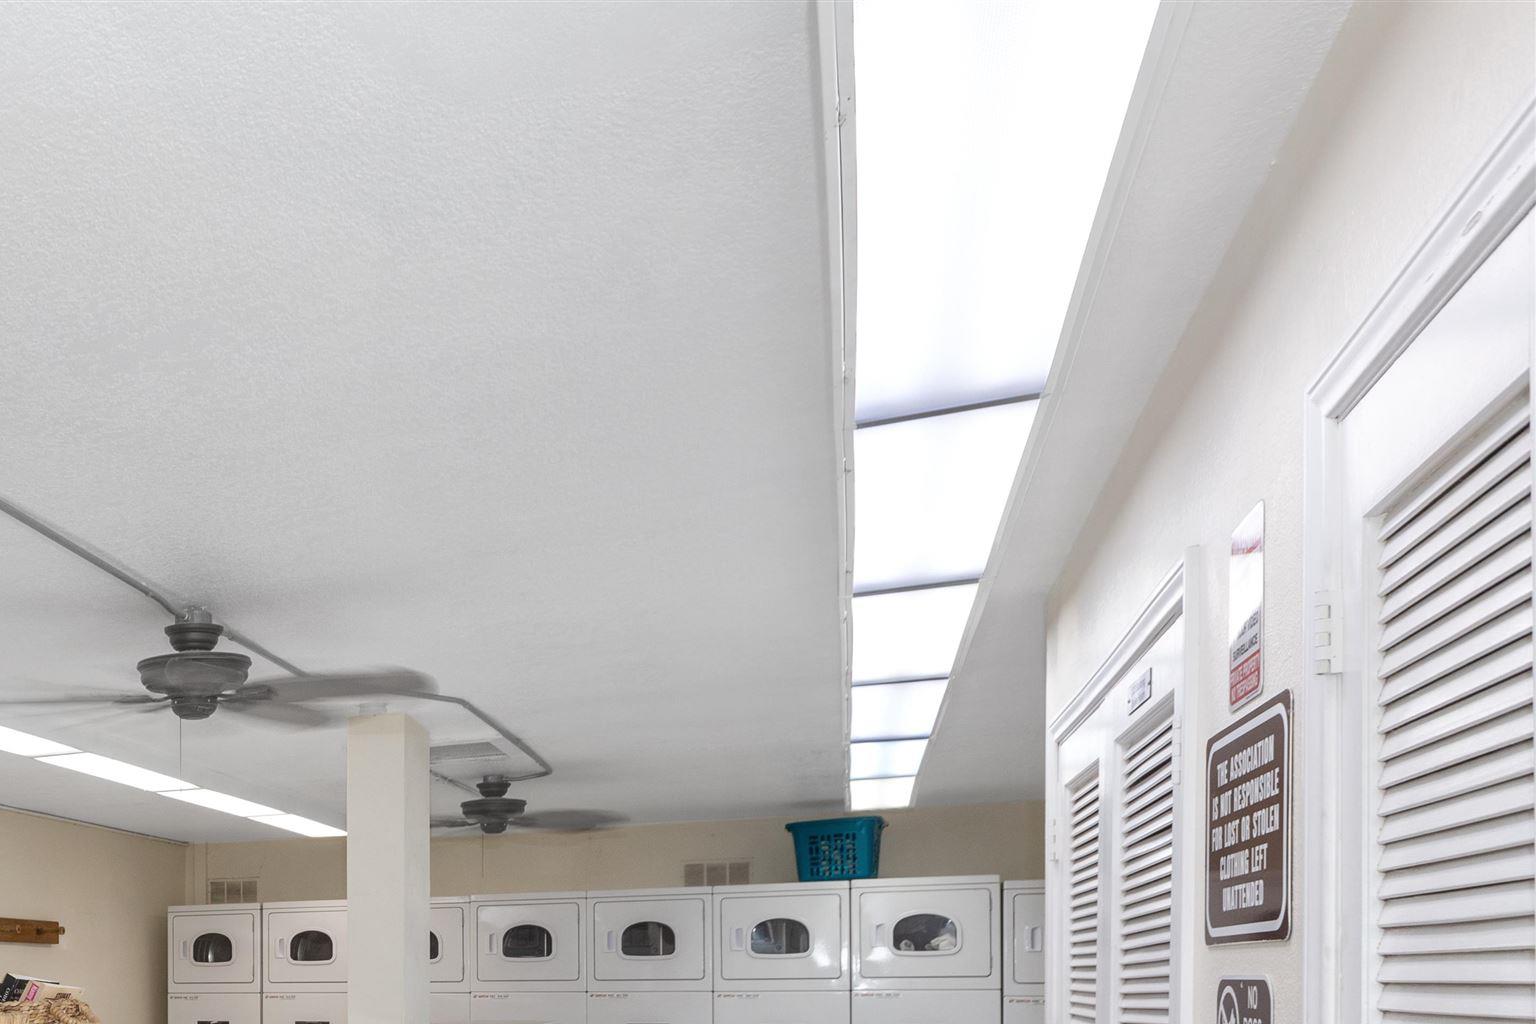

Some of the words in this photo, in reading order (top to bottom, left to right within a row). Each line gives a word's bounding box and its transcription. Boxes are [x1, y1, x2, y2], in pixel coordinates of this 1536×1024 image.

[1217, 758, 1228, 788] THE
[1230, 734, 1275, 781] ASSOCIATION
[1212, 797, 1218, 821] IS
[1220, 790, 1232, 817] NOT
[1233, 767, 1280, 812] RESPONSIBLE
[1211, 826, 1223, 852] FOR
[1224, 818, 1239, 849] LOST
[1240, 814, 1250, 843] OR
[1252, 803, 1280, 839] STOLEN
[1219, 849, 1249, 880] CLOTHING
[1250, 843, 1268, 872] LEFT
[1222, 879, 1264, 912] UNATTENDED
[1247, 985, 1258, 1009] NO
